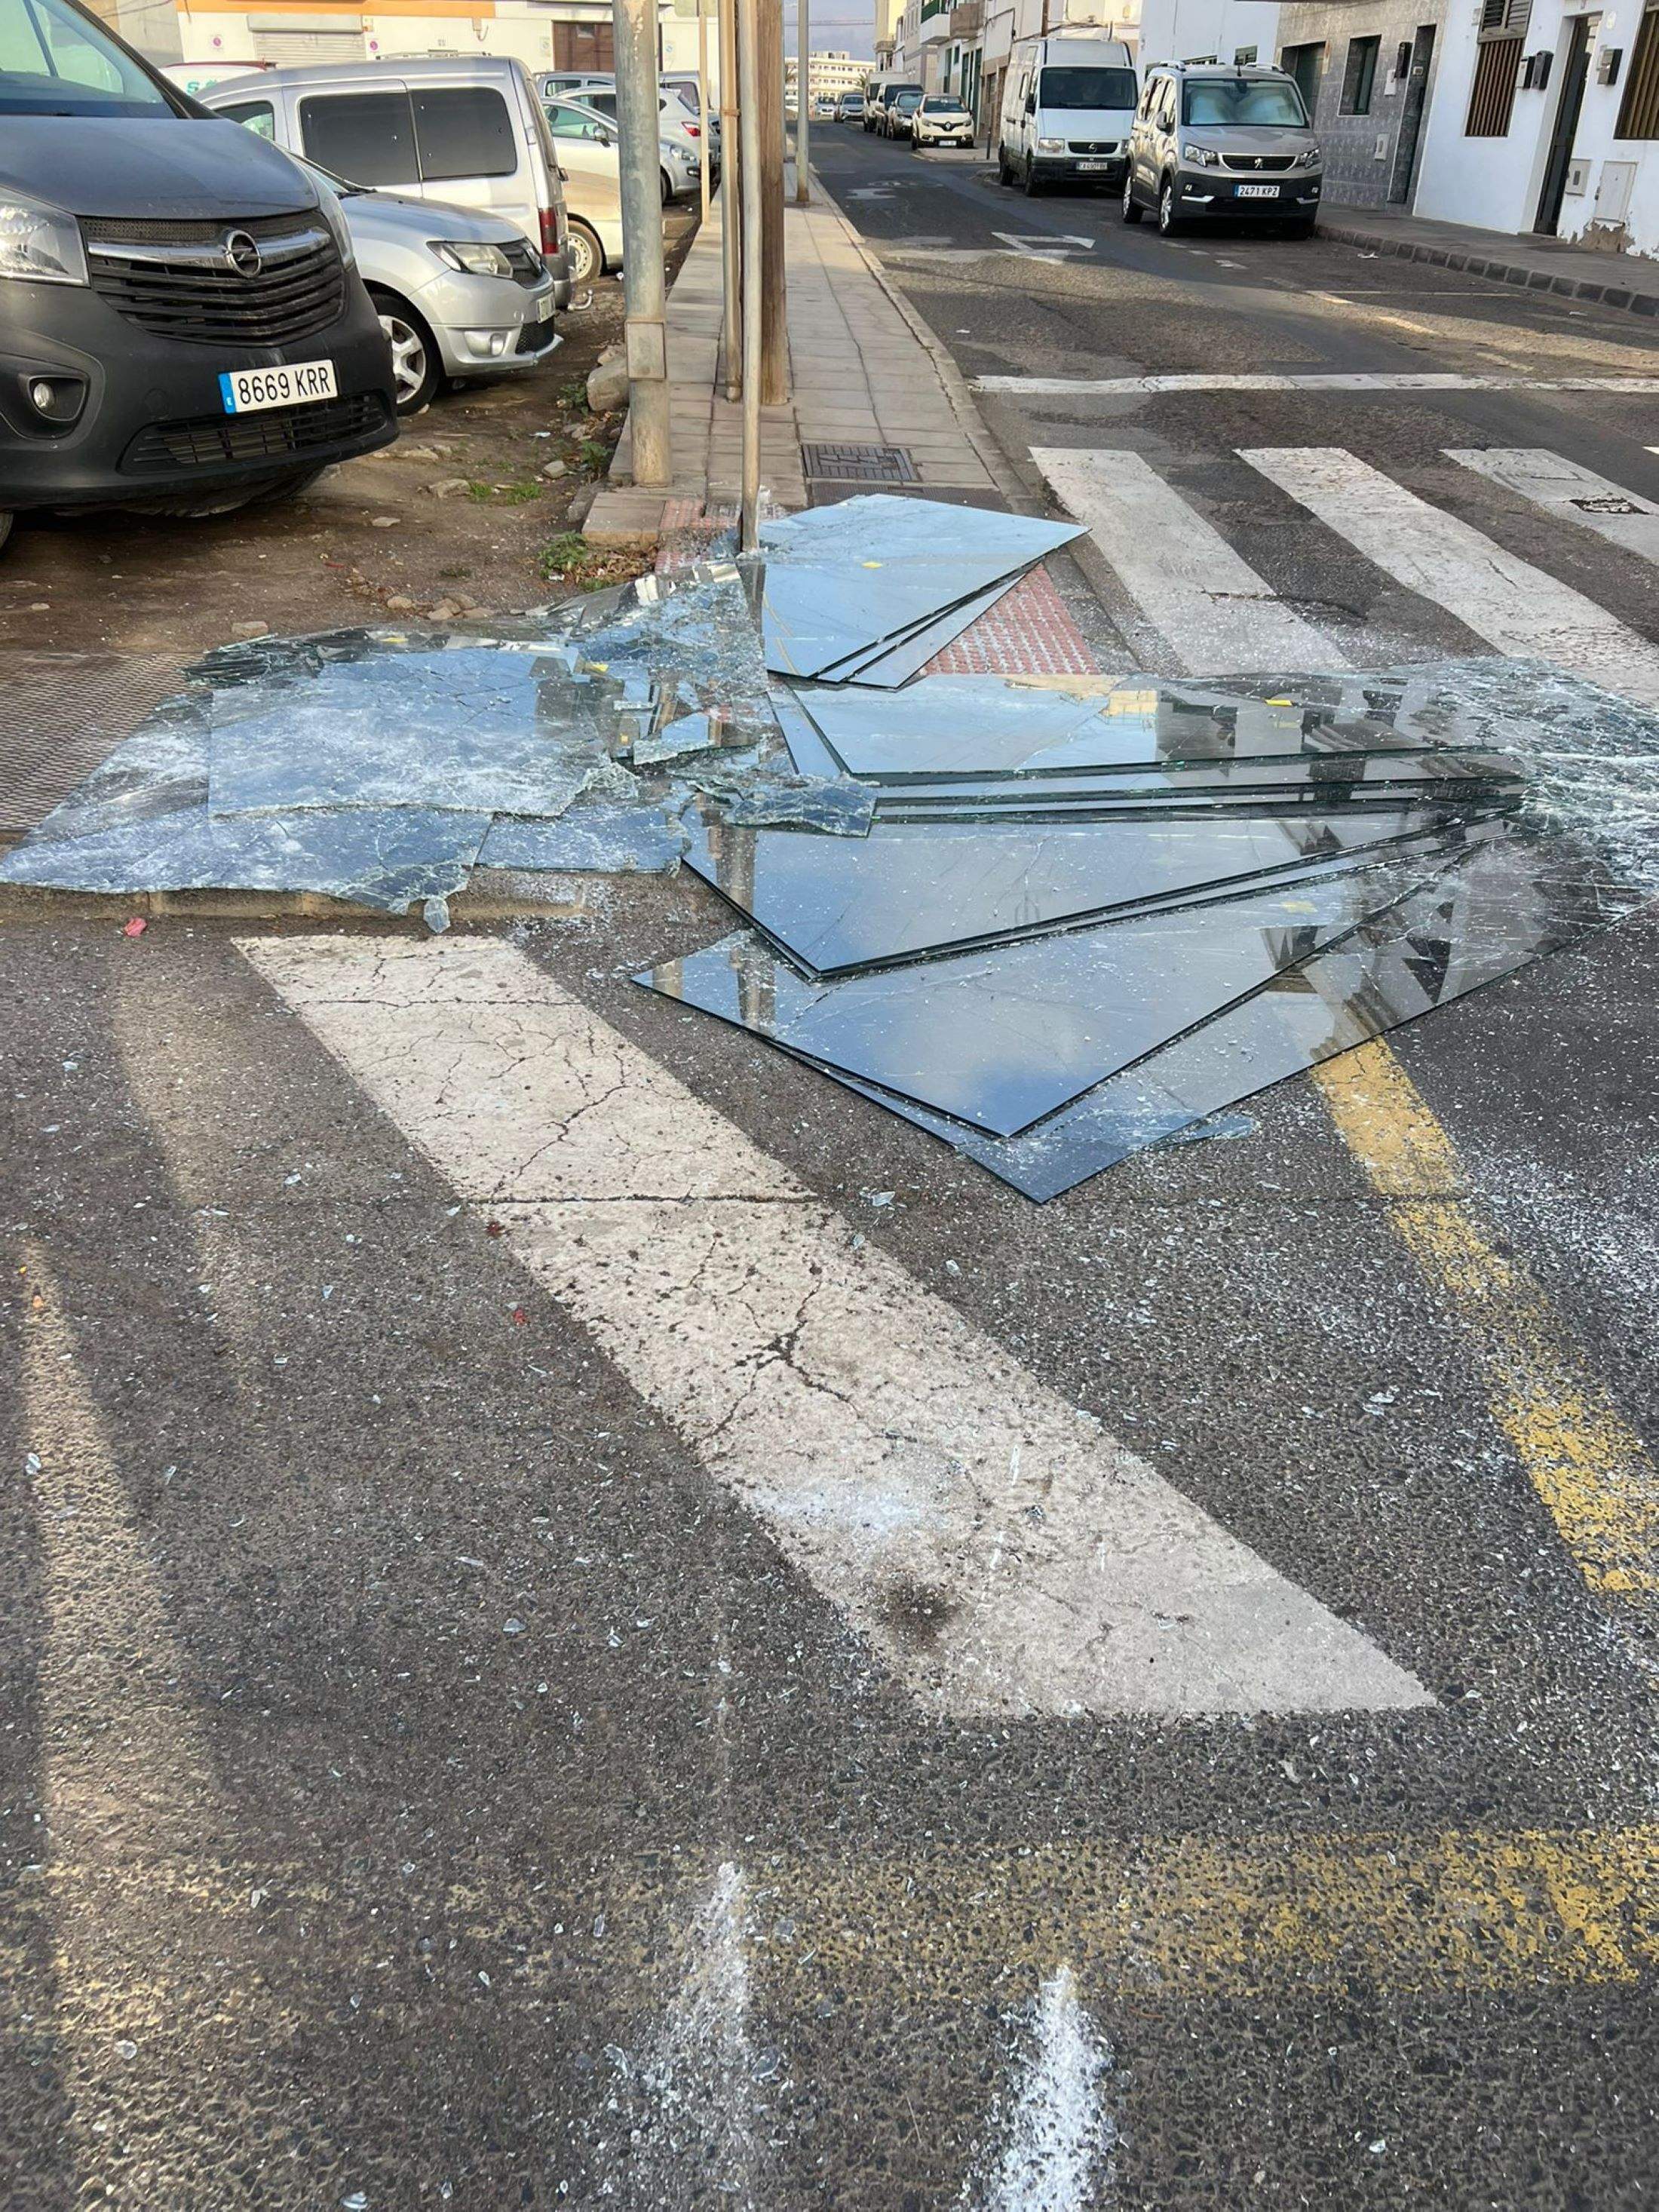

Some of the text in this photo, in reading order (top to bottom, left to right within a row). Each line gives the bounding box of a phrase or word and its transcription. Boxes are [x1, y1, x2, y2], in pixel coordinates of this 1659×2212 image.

[1240, 187, 1278, 195] 2471 KPZ
[238, 367, 330, 404] 8669 KRR
